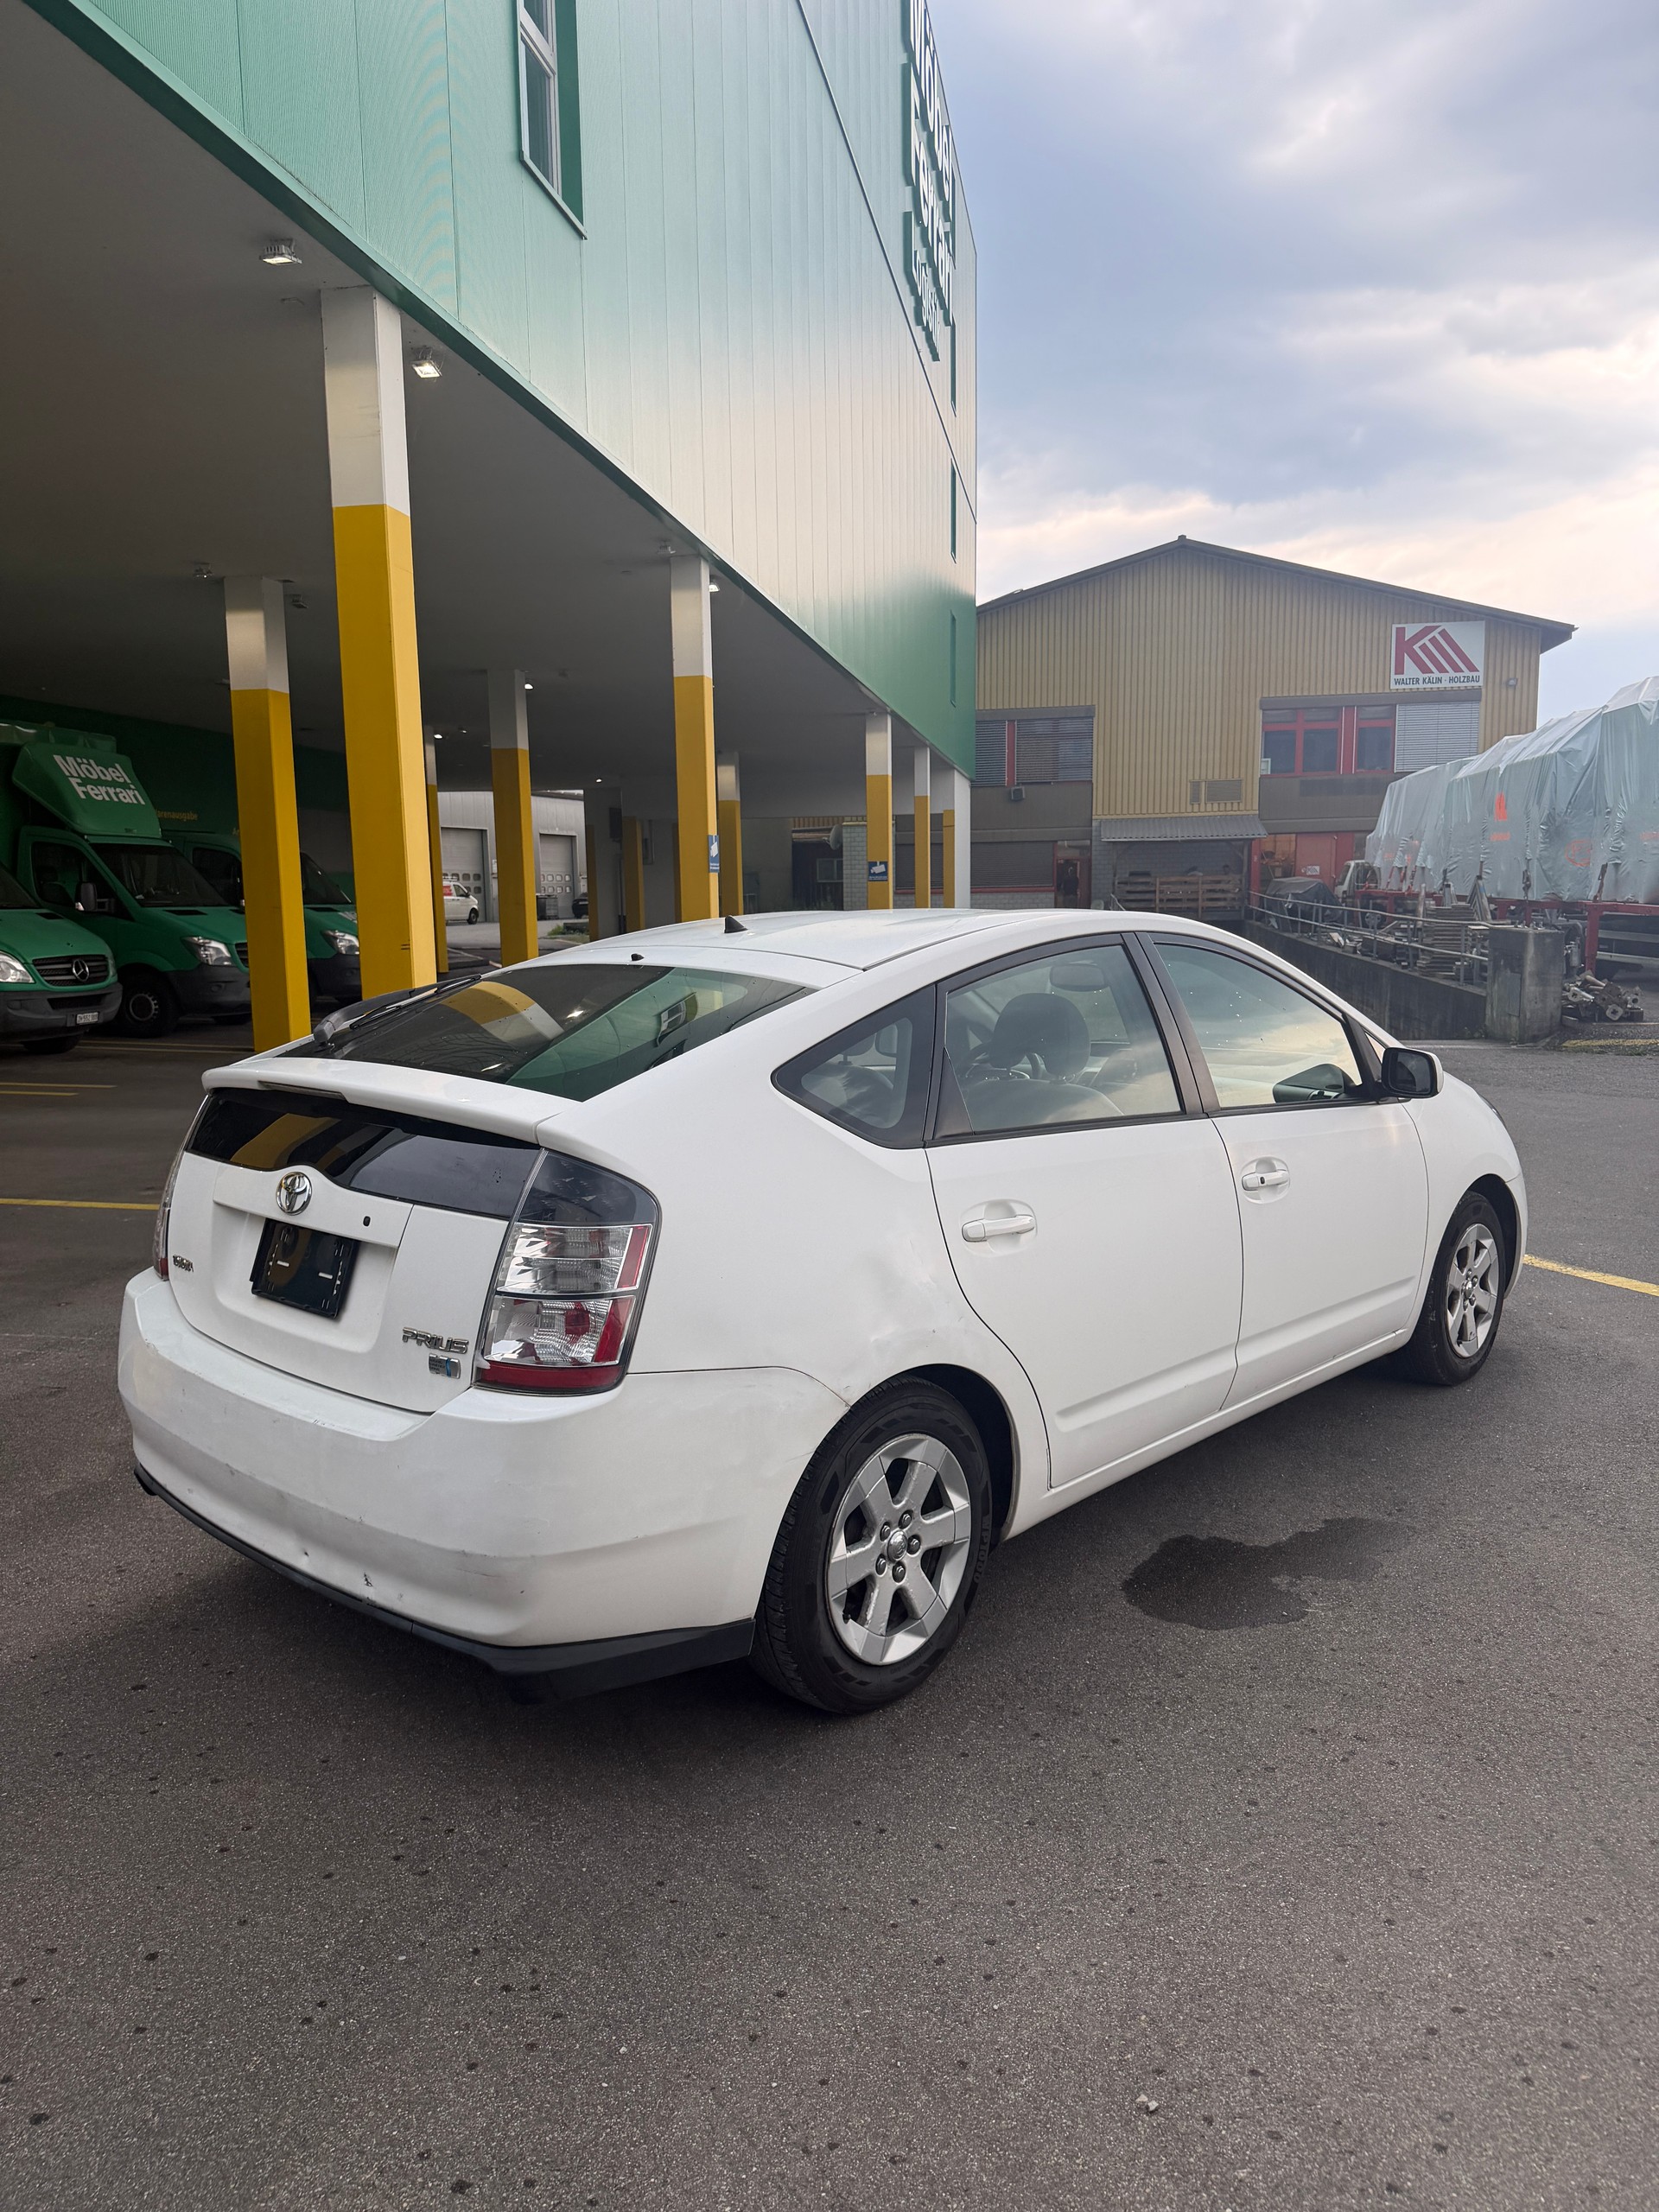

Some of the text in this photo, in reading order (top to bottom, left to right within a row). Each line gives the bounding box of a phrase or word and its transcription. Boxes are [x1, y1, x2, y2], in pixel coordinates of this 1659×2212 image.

[910, 0, 952, 222] Möbel
[911, 62, 953, 327] Ferrari
[1422, 676, 1442, 684] KÄLIN
[1448, 675, 1480, 683] HOLZBAU
[54, 754, 131, 784] Möbel
[68, 778, 145, 804] Ferrari
[403, 1326, 469, 1355] PRIUS
